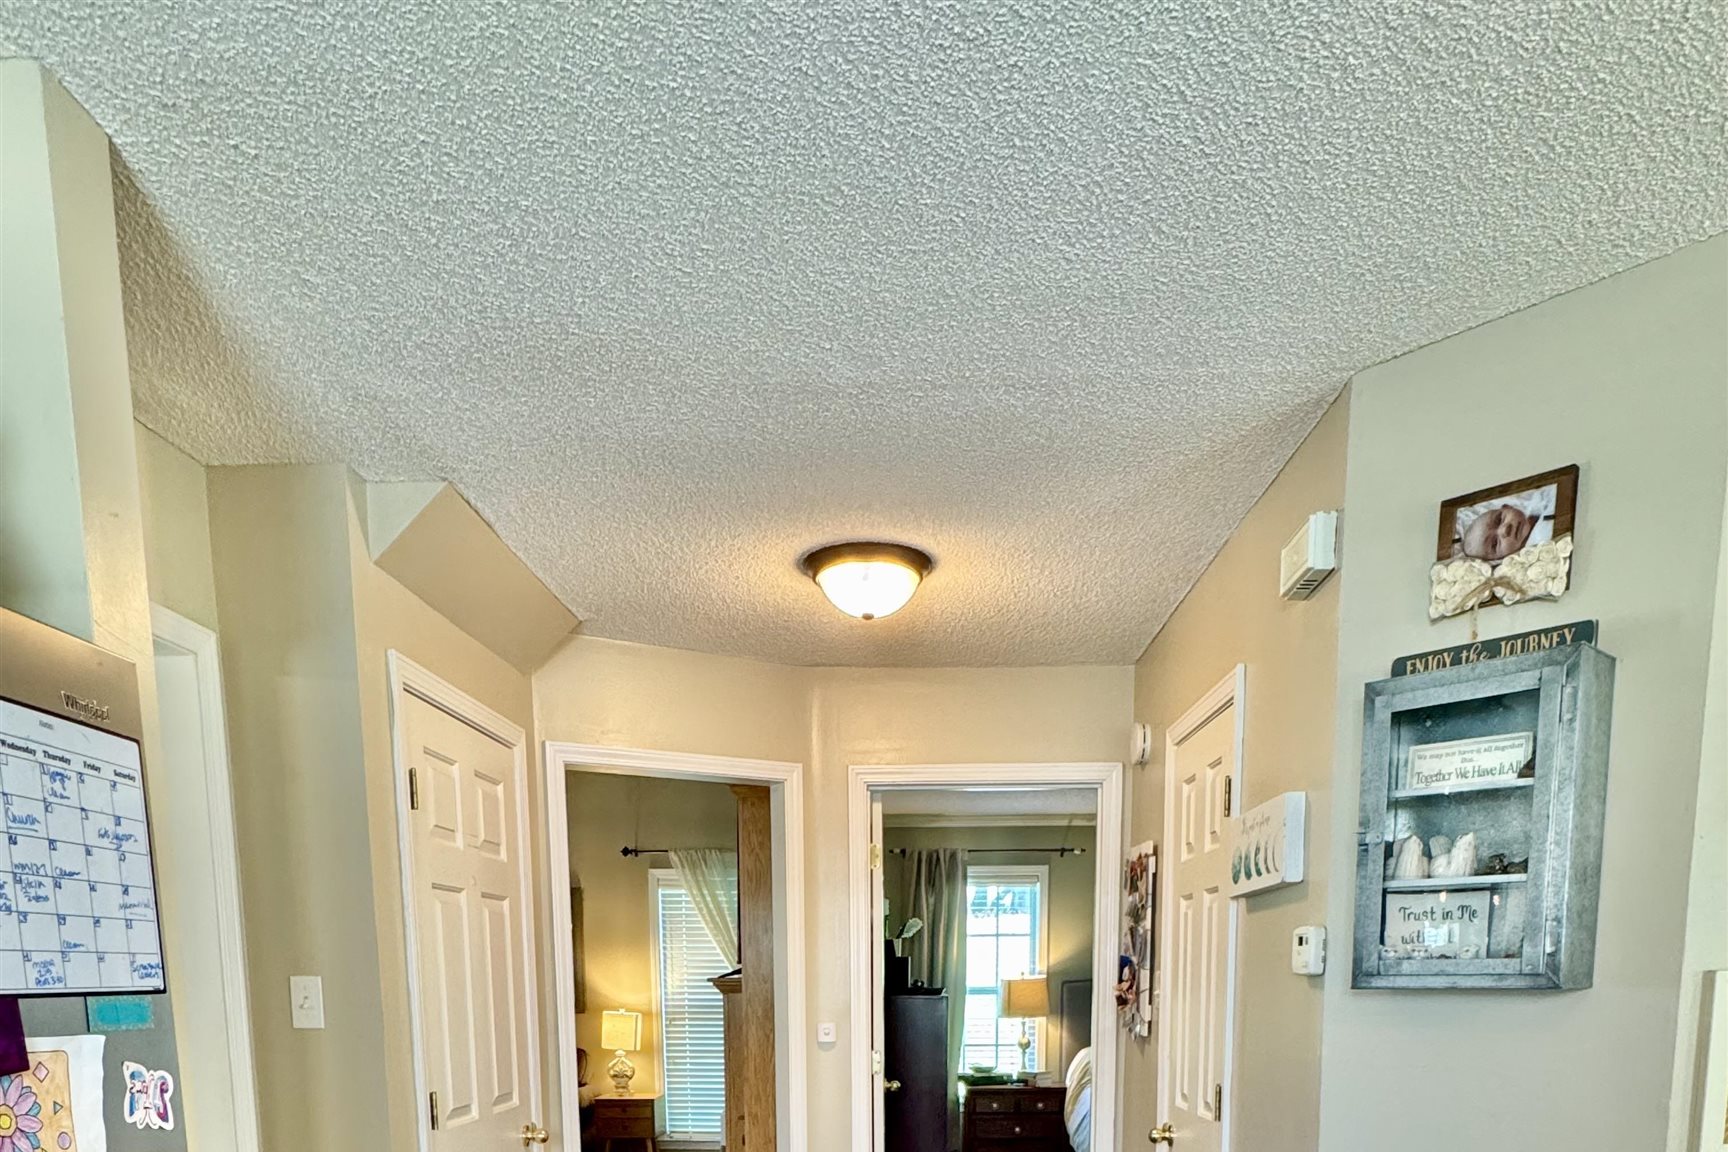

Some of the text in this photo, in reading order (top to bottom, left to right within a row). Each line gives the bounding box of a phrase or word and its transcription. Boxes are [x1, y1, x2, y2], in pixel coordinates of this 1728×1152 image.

[1406, 627, 1576, 675] ENJOY the JOURNEY
[0, 739, 137, 783] Wednesday Thursday Friday Saturday
[1415, 769, 1453, 786] Together
[1455, 767, 1470, 779] We
[1471, 764, 1497, 779] Have
[1499, 762, 1506, 775] It
[1399, 904, 1479, 923] Trust in Me
